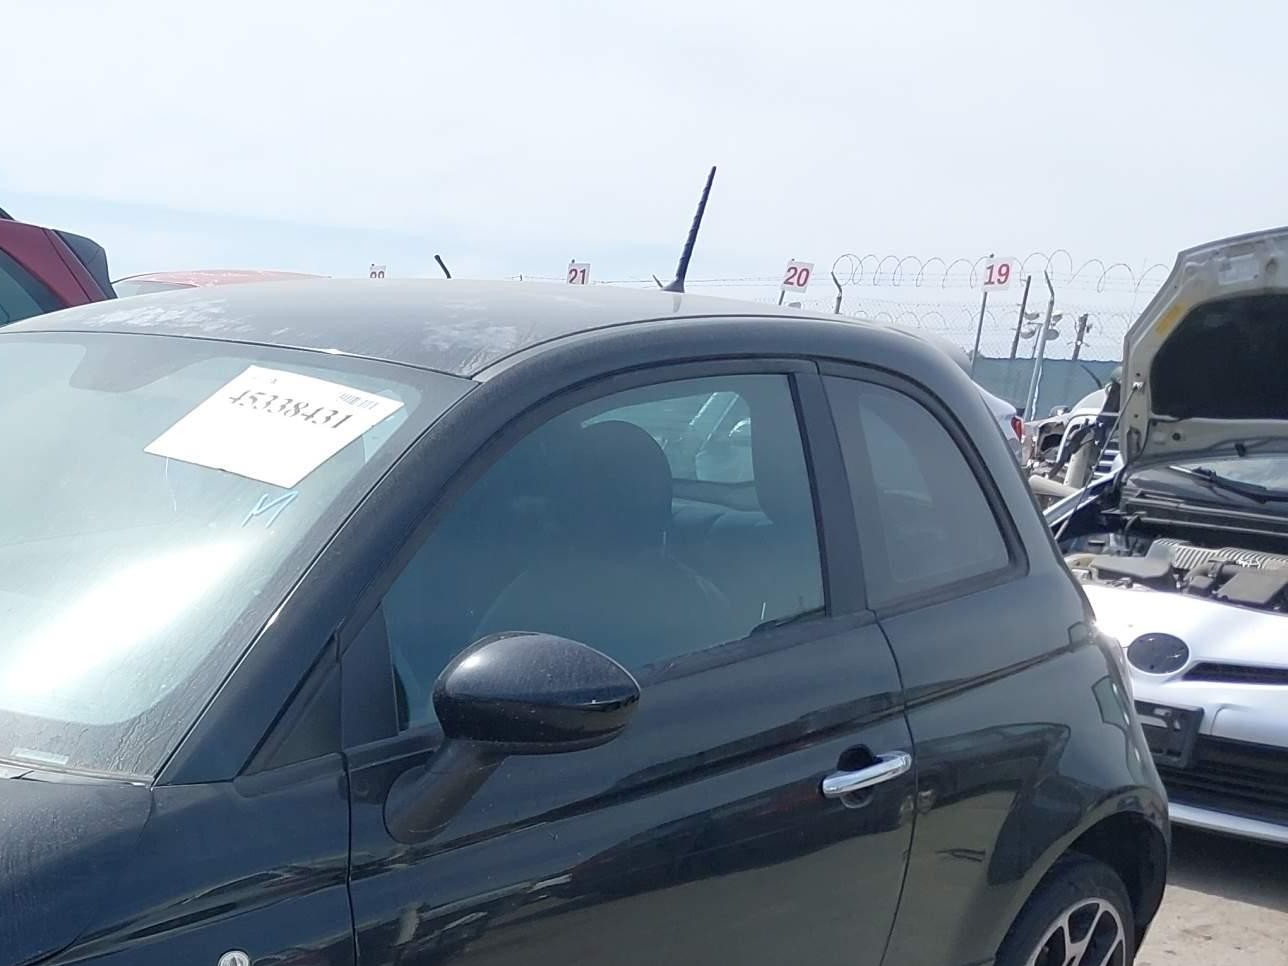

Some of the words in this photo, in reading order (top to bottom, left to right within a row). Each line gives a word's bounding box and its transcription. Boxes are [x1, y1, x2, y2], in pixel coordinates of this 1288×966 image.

[568, 268, 586, 285] 21
[783, 266, 810, 287] 20
[984, 264, 1010, 285] 19
[228, 389, 353, 428] 45338431
